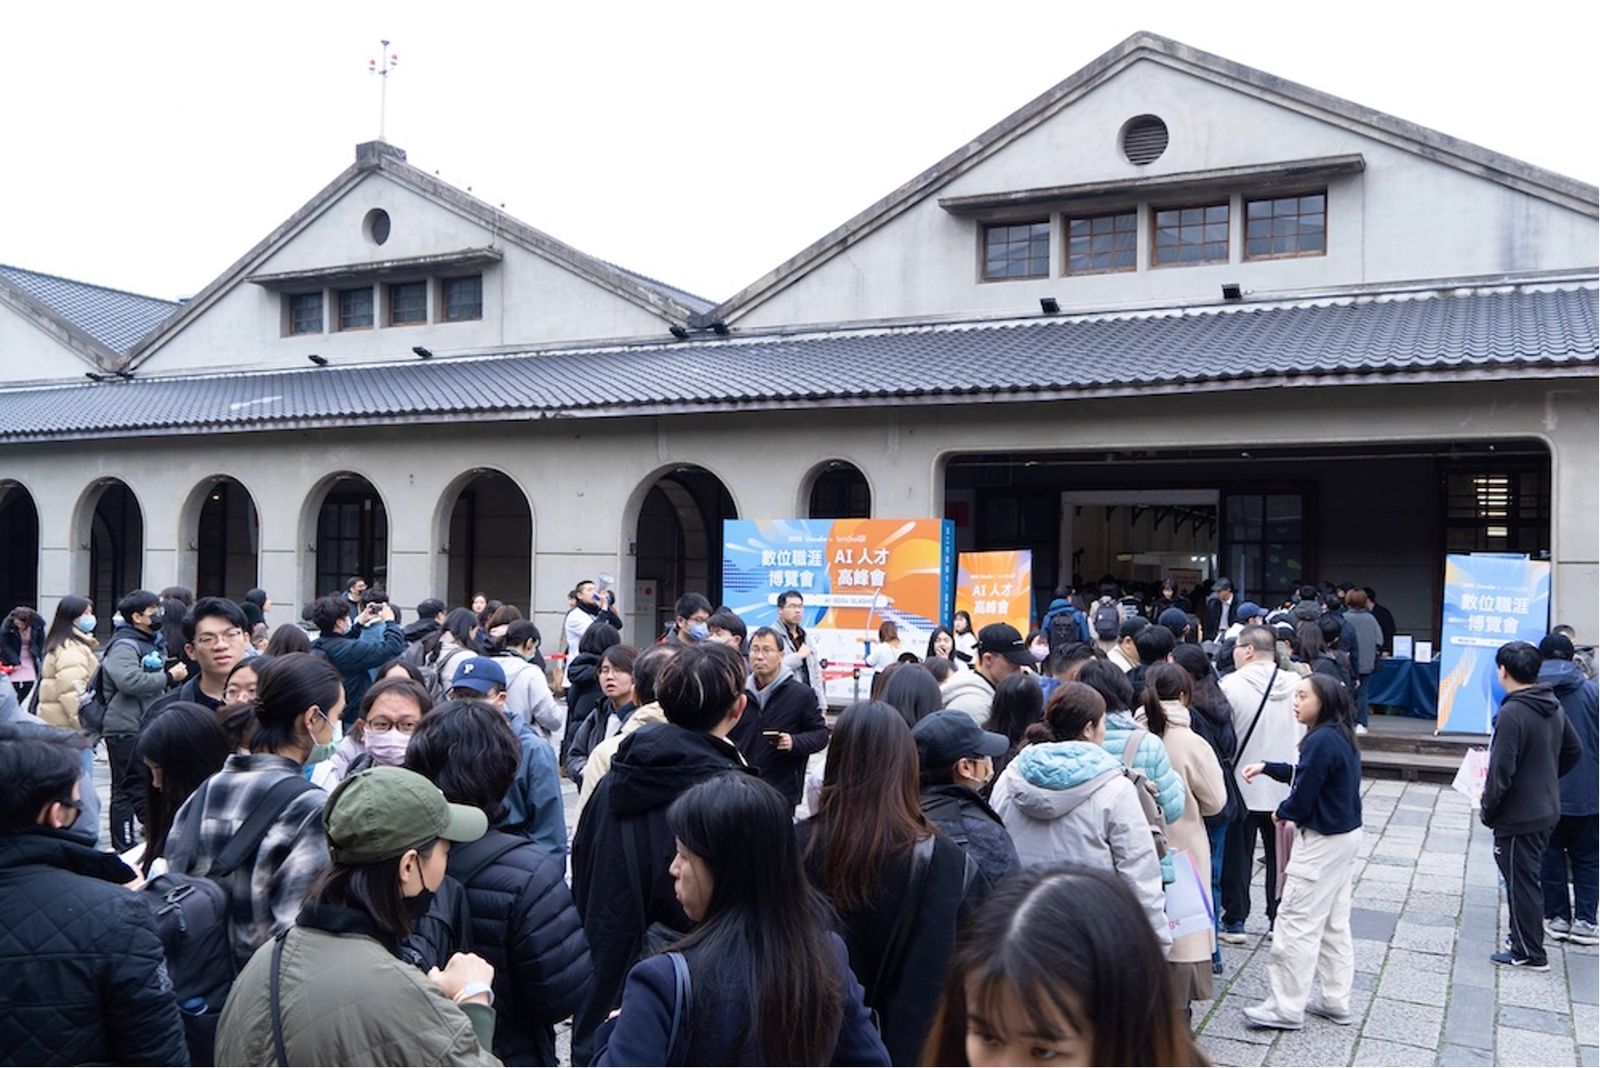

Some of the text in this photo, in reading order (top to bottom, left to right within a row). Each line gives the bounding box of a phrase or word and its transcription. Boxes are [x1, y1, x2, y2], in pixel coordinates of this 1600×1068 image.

[761, 549, 823, 566] 數位職涯
[834, 548, 890, 564] AI 人才
[768, 569, 815, 587] 博覽會
[837, 569, 886, 587] 高峰會
[972, 582, 1013, 597] AI 人才
[973, 599, 1009, 615] 高峰會
[1461, 593, 1530, 615] 數位職涯
[1467, 614, 1519, 634] 博覽會
[463, 663, 475, 675] P
